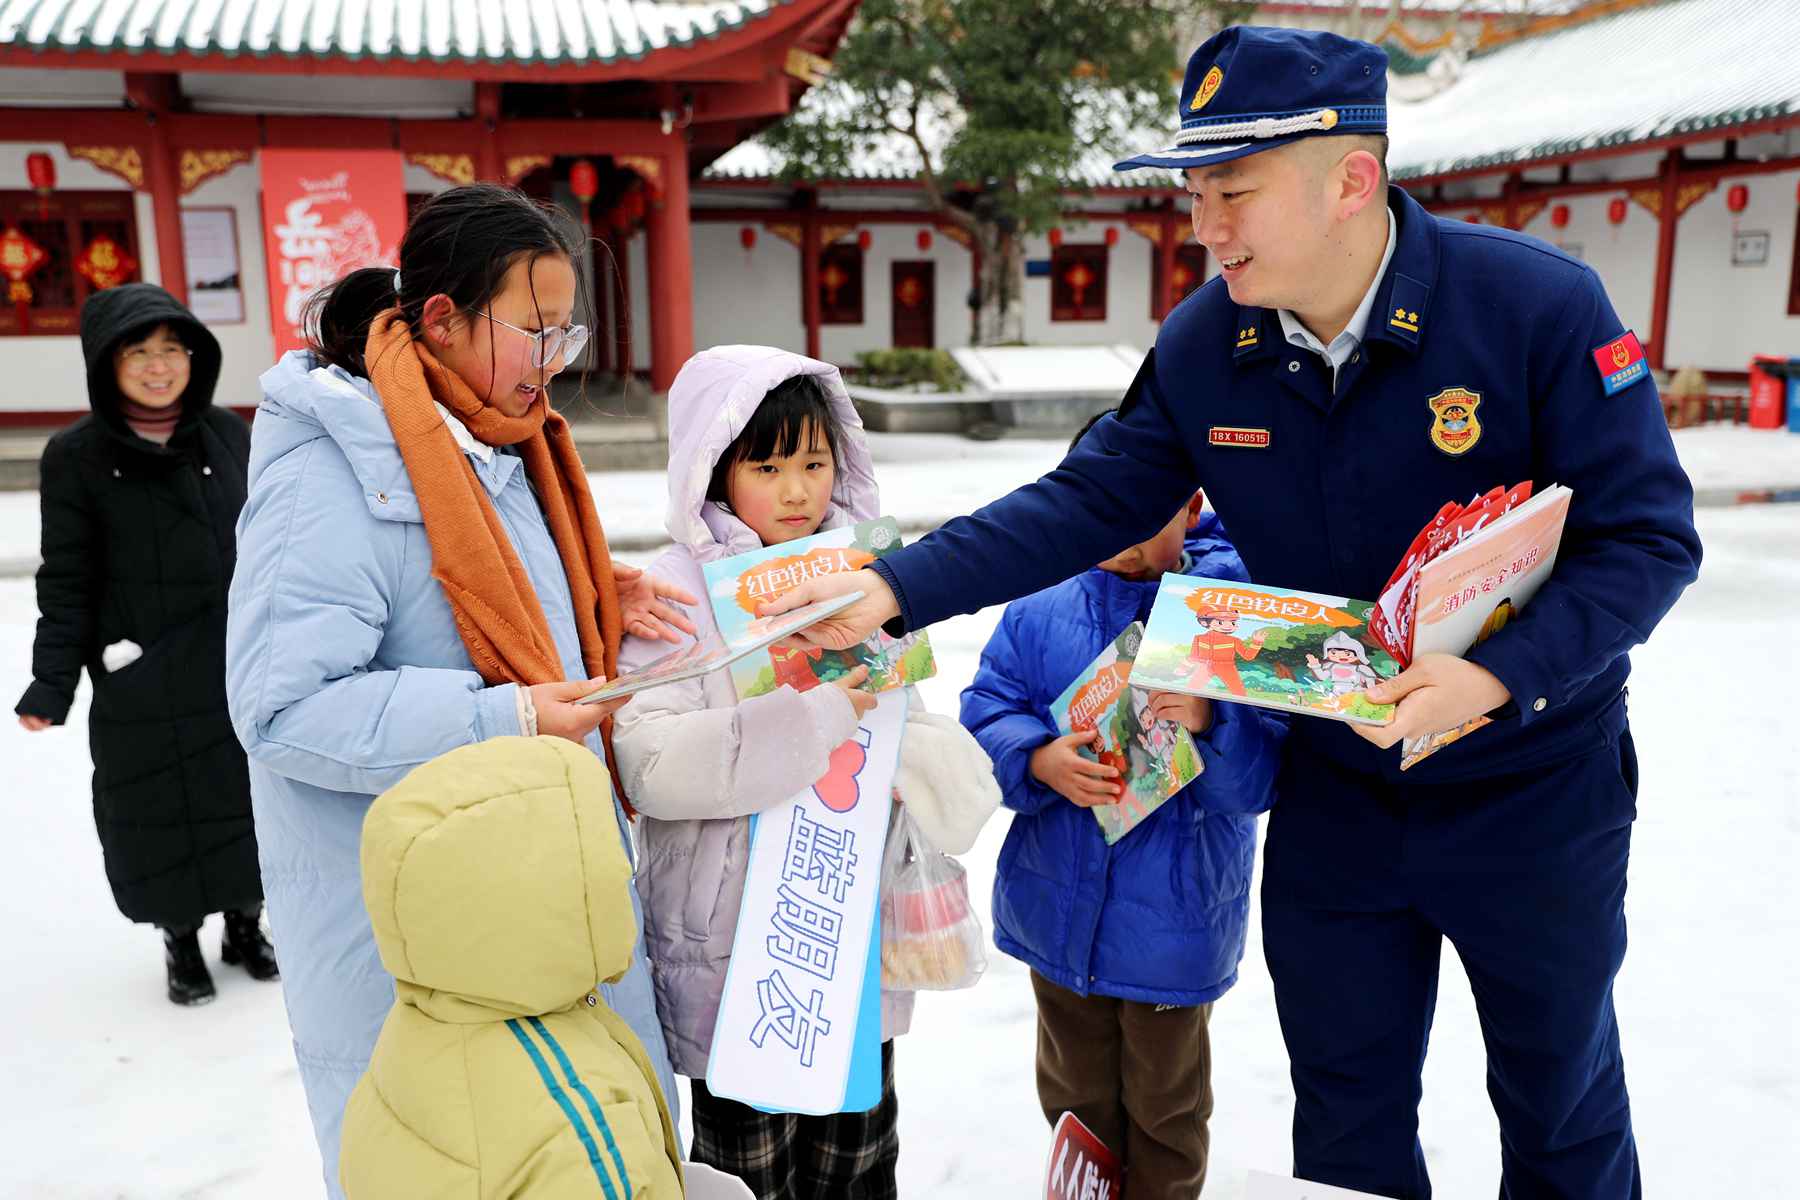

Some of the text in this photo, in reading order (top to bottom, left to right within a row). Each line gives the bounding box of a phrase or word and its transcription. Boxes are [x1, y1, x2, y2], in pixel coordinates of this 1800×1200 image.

[1212, 431, 1266, 443] 18X 160515
[747, 550, 853, 597] 红色铁皮人
[1443, 547, 1538, 615] 消防安全知识
[1200, 591, 1332, 623] 红色铁皮人
[1072, 666, 1123, 724] 红色铁皮人
[749, 805, 858, 1067] 蓝朋友
